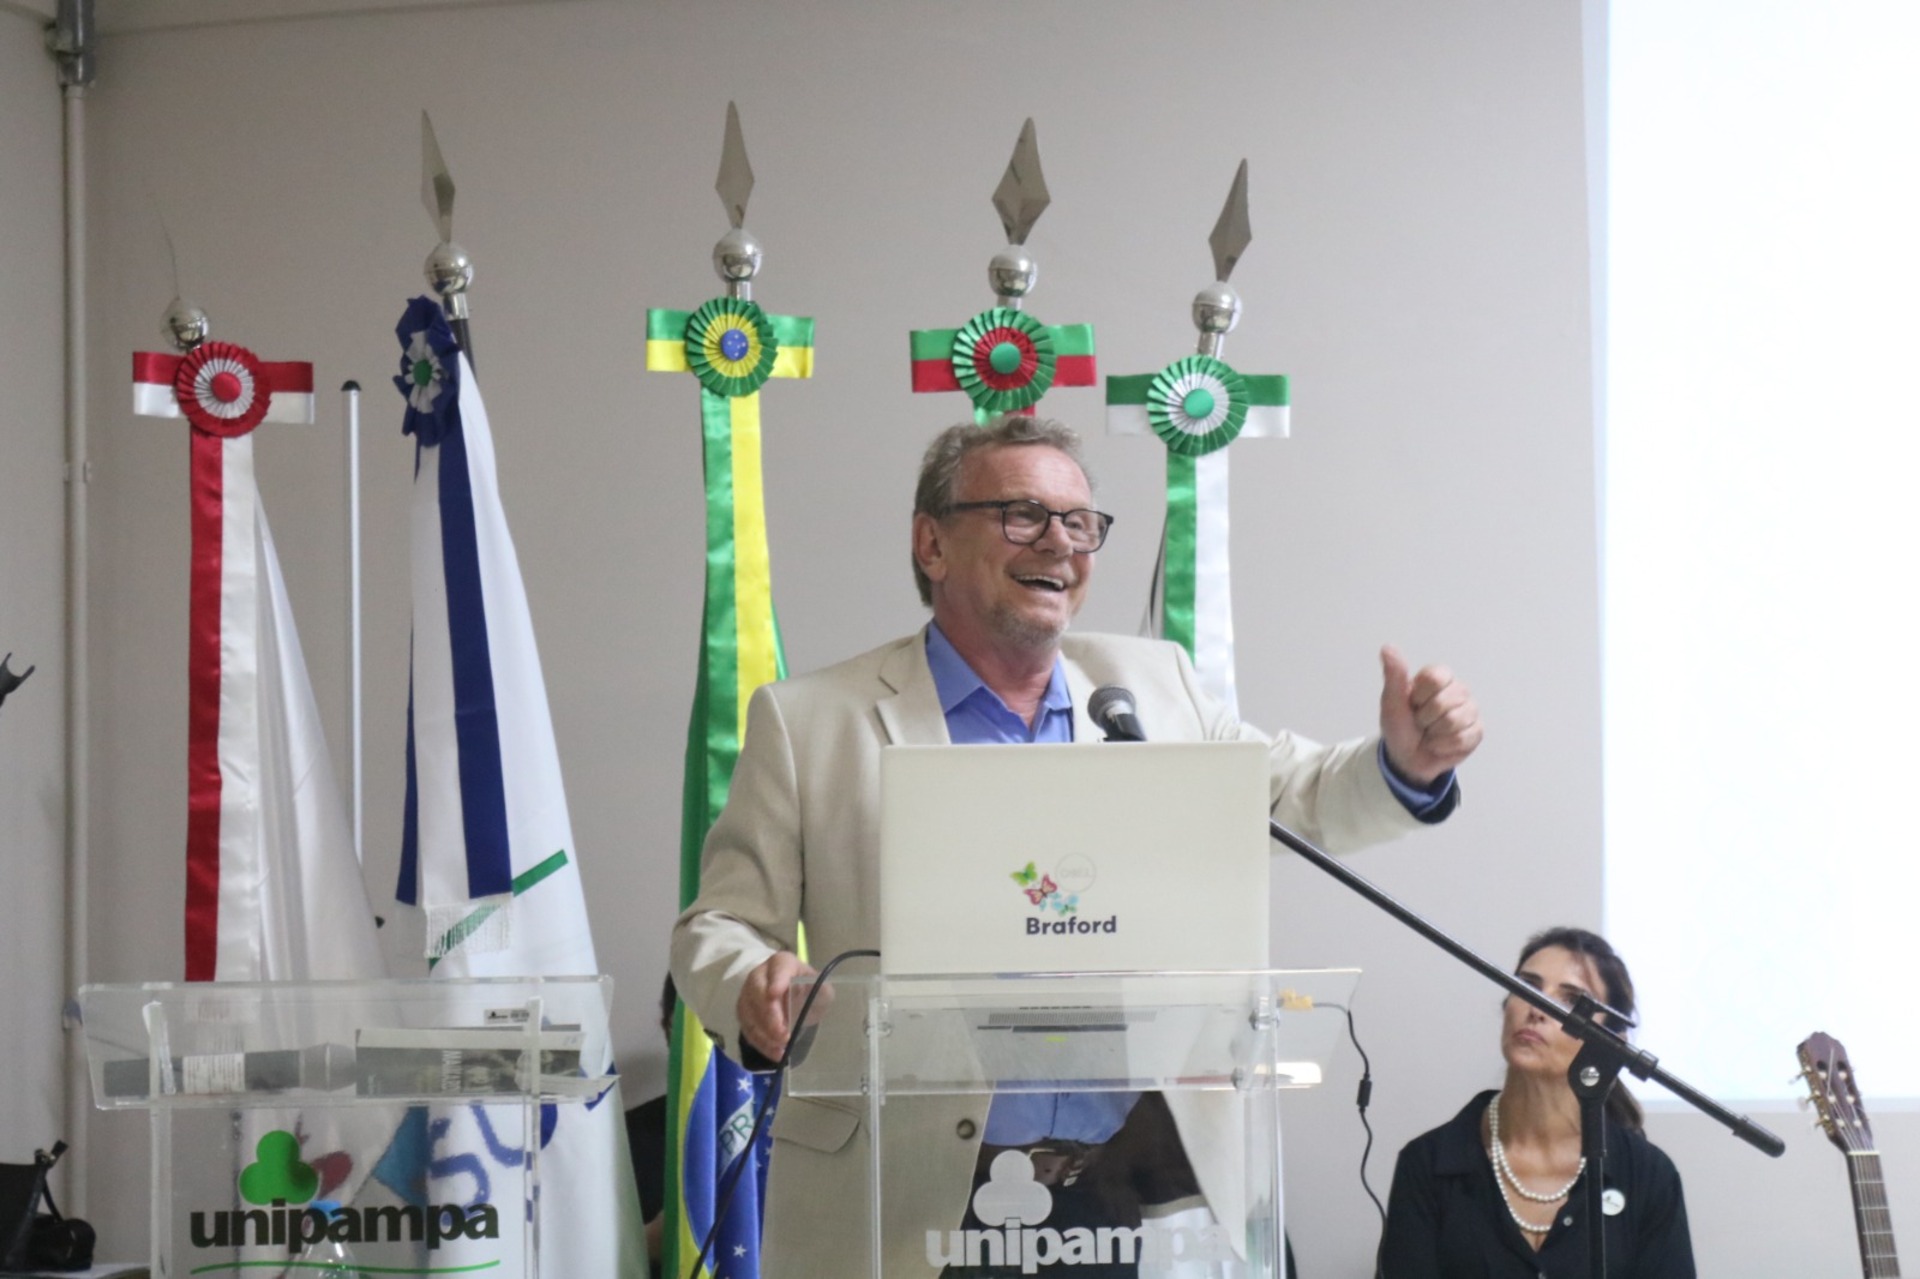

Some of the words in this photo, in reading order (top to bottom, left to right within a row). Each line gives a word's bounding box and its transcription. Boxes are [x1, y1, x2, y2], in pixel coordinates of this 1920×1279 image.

[1026, 915, 1117, 935] Braford
[190, 1199, 500, 1254] unipampa
[926, 1217, 1235, 1274] unipampa
